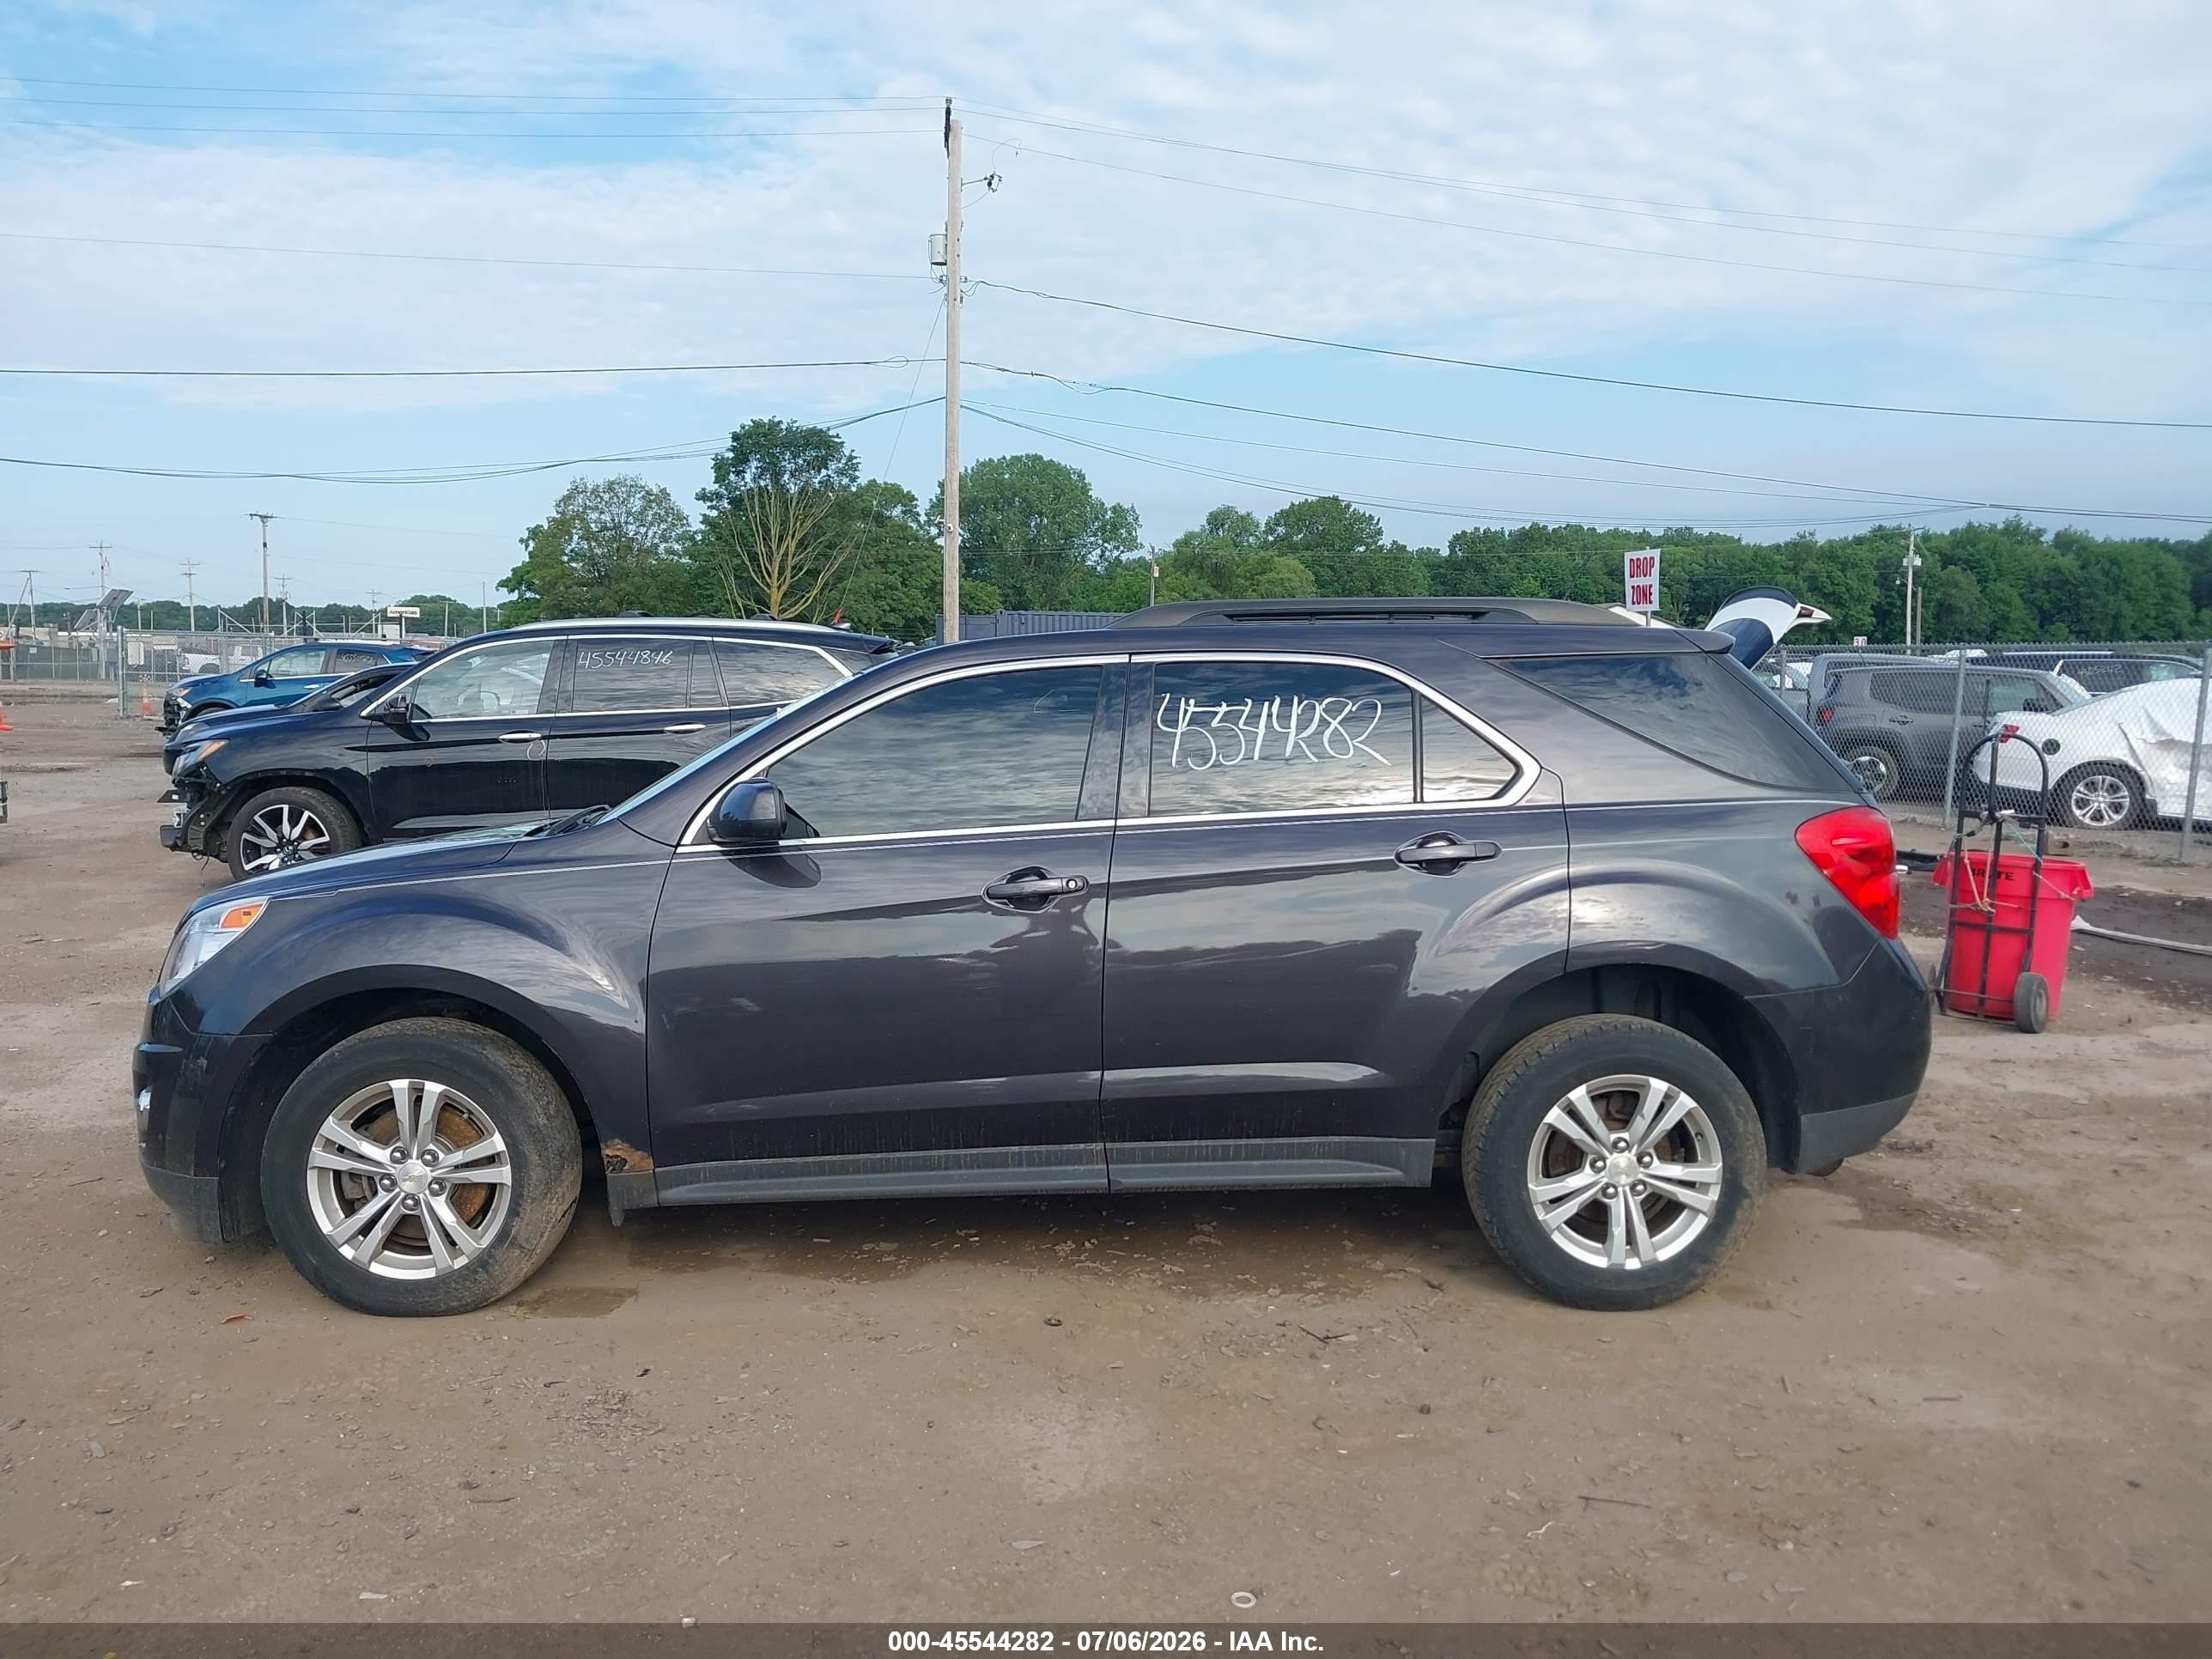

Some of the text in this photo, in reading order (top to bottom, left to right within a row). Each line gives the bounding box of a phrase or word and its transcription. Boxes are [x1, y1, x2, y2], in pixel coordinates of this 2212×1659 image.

[1629, 556, 1656, 579] DROP
[1631, 583, 1654, 605] ZONE
[578, 650, 673, 669] 45544846
